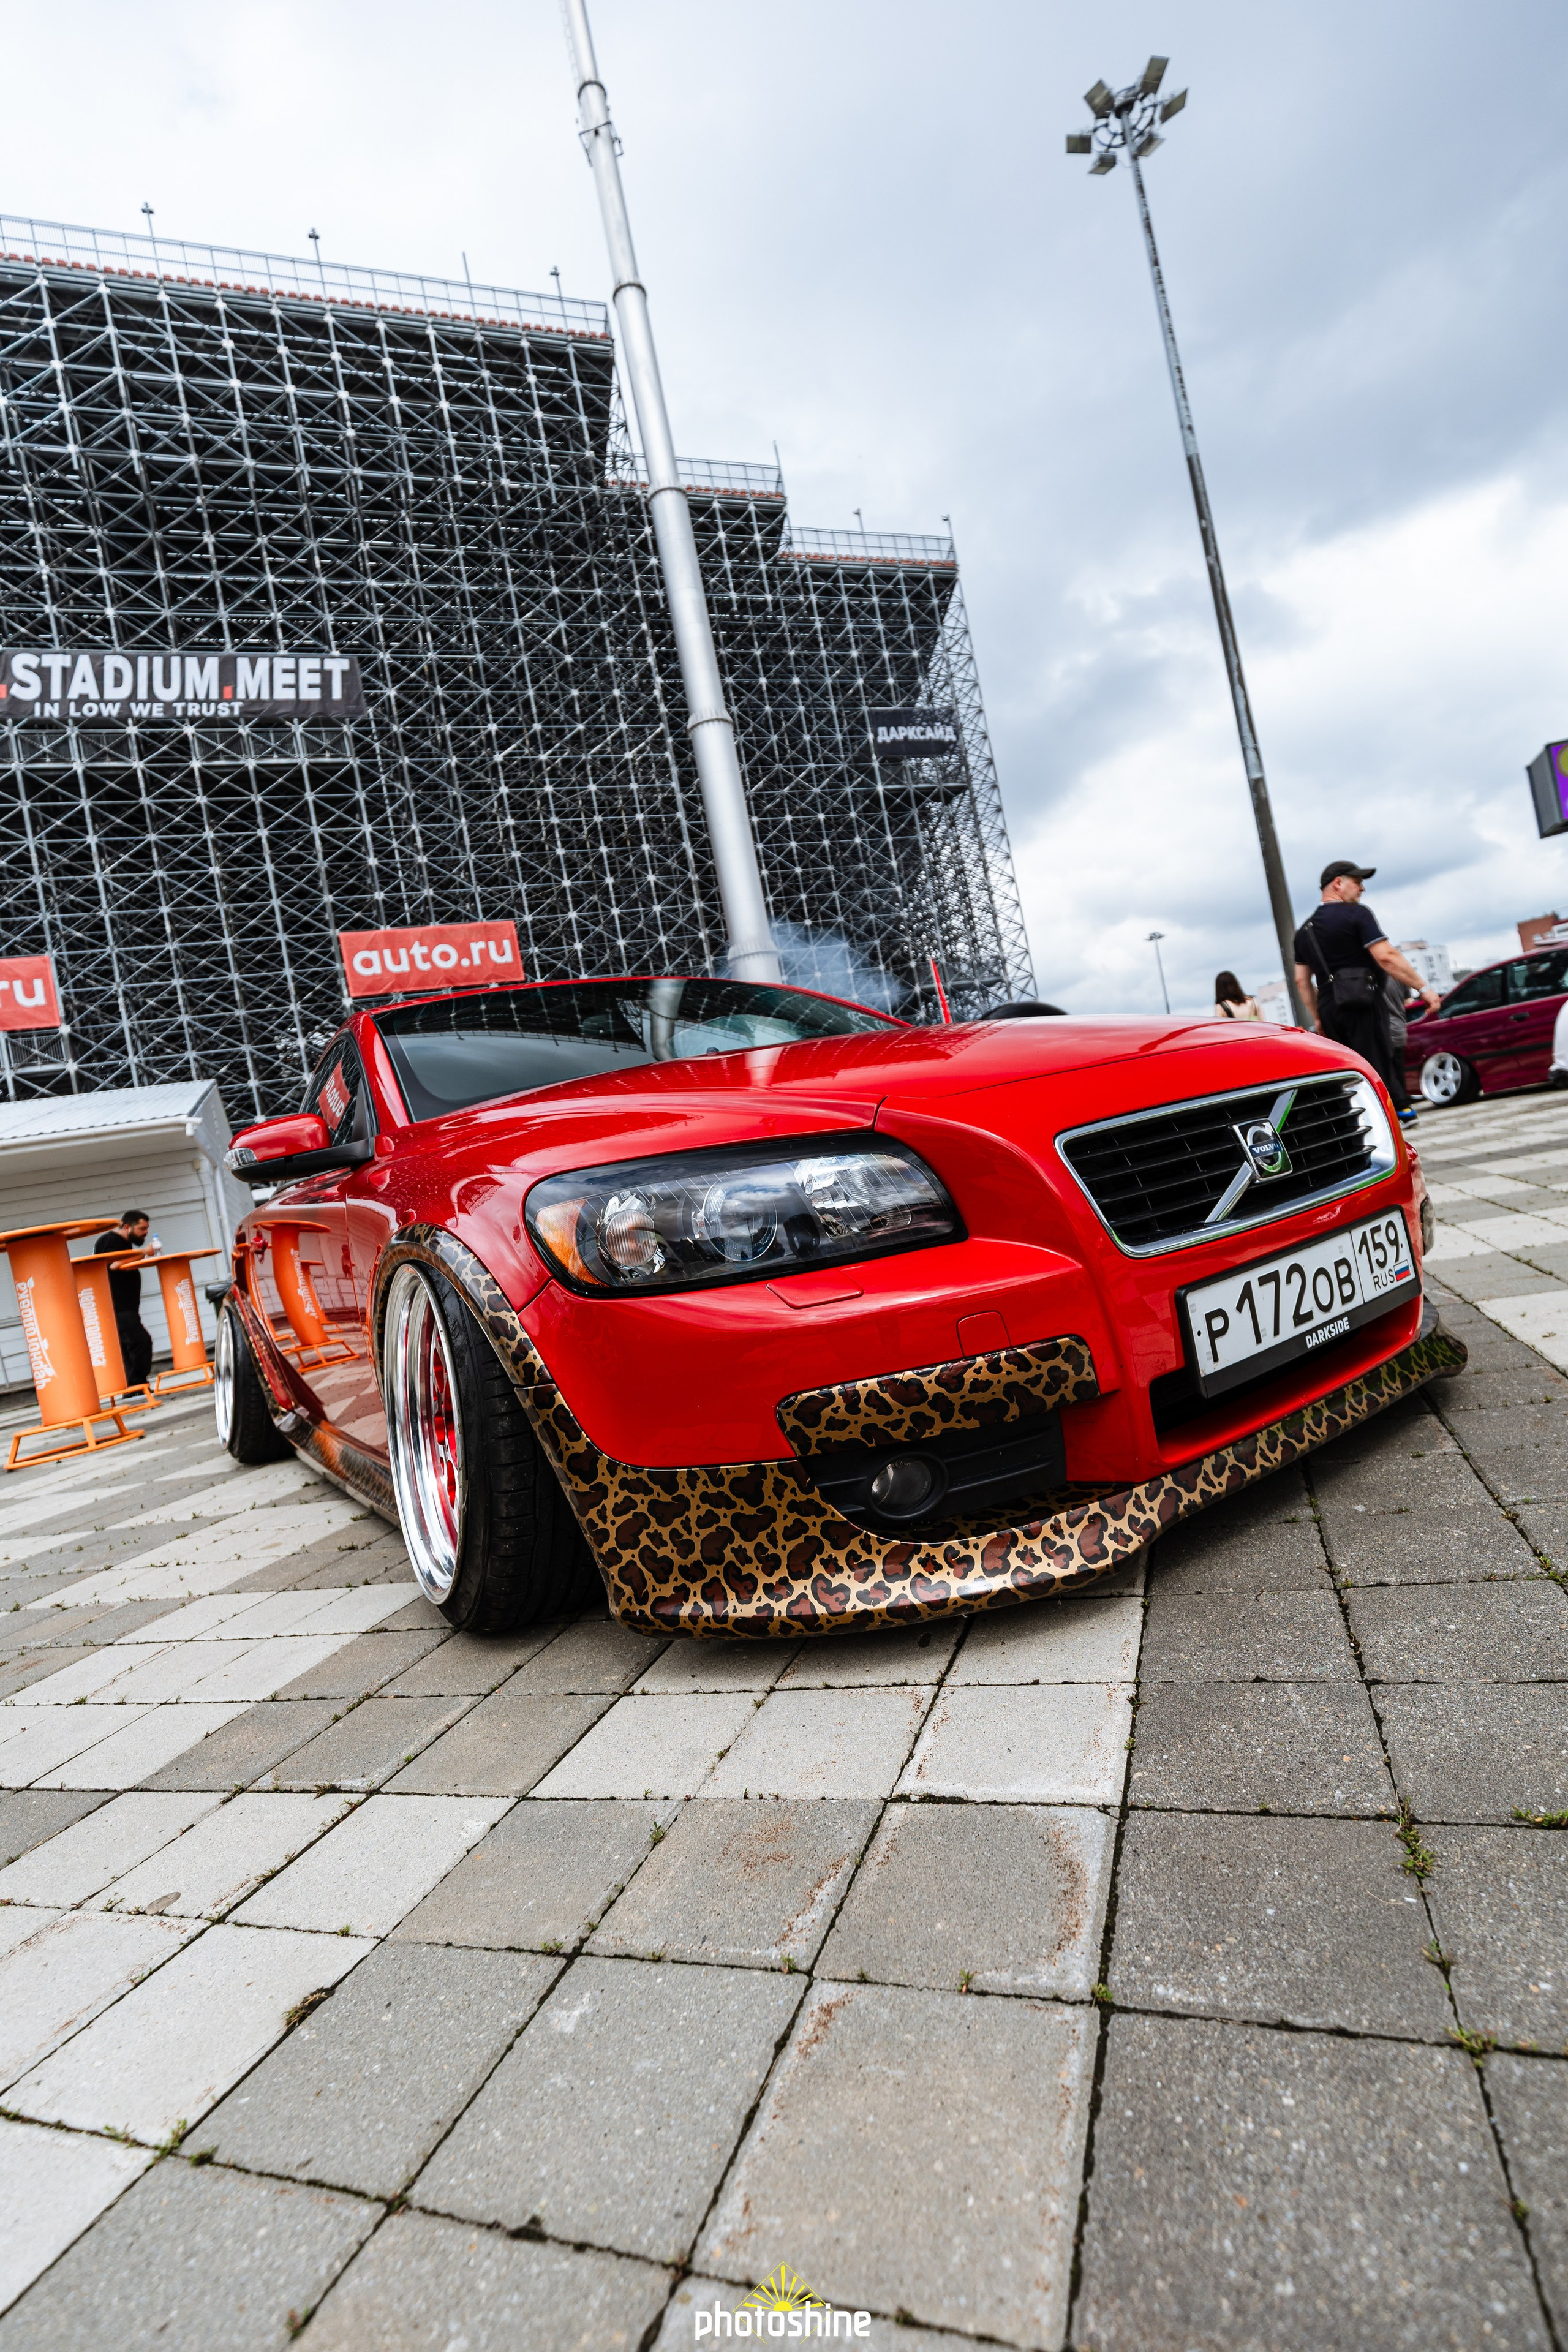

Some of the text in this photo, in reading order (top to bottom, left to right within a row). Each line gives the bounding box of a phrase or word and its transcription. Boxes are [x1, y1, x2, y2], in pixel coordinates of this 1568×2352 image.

[34, 701, 244, 718] IN LOW WE TRUST
[876, 723, 957, 743] ДАРКСАЙД
[353, 939, 513, 976] auto.ru
[1252, 1142, 1280, 1154] VOLVO
[1358, 1219, 1400, 1274] 159
[1373, 1268, 1395, 1291] RUS
[1305, 1317, 1350, 1349] DARKSIDE
